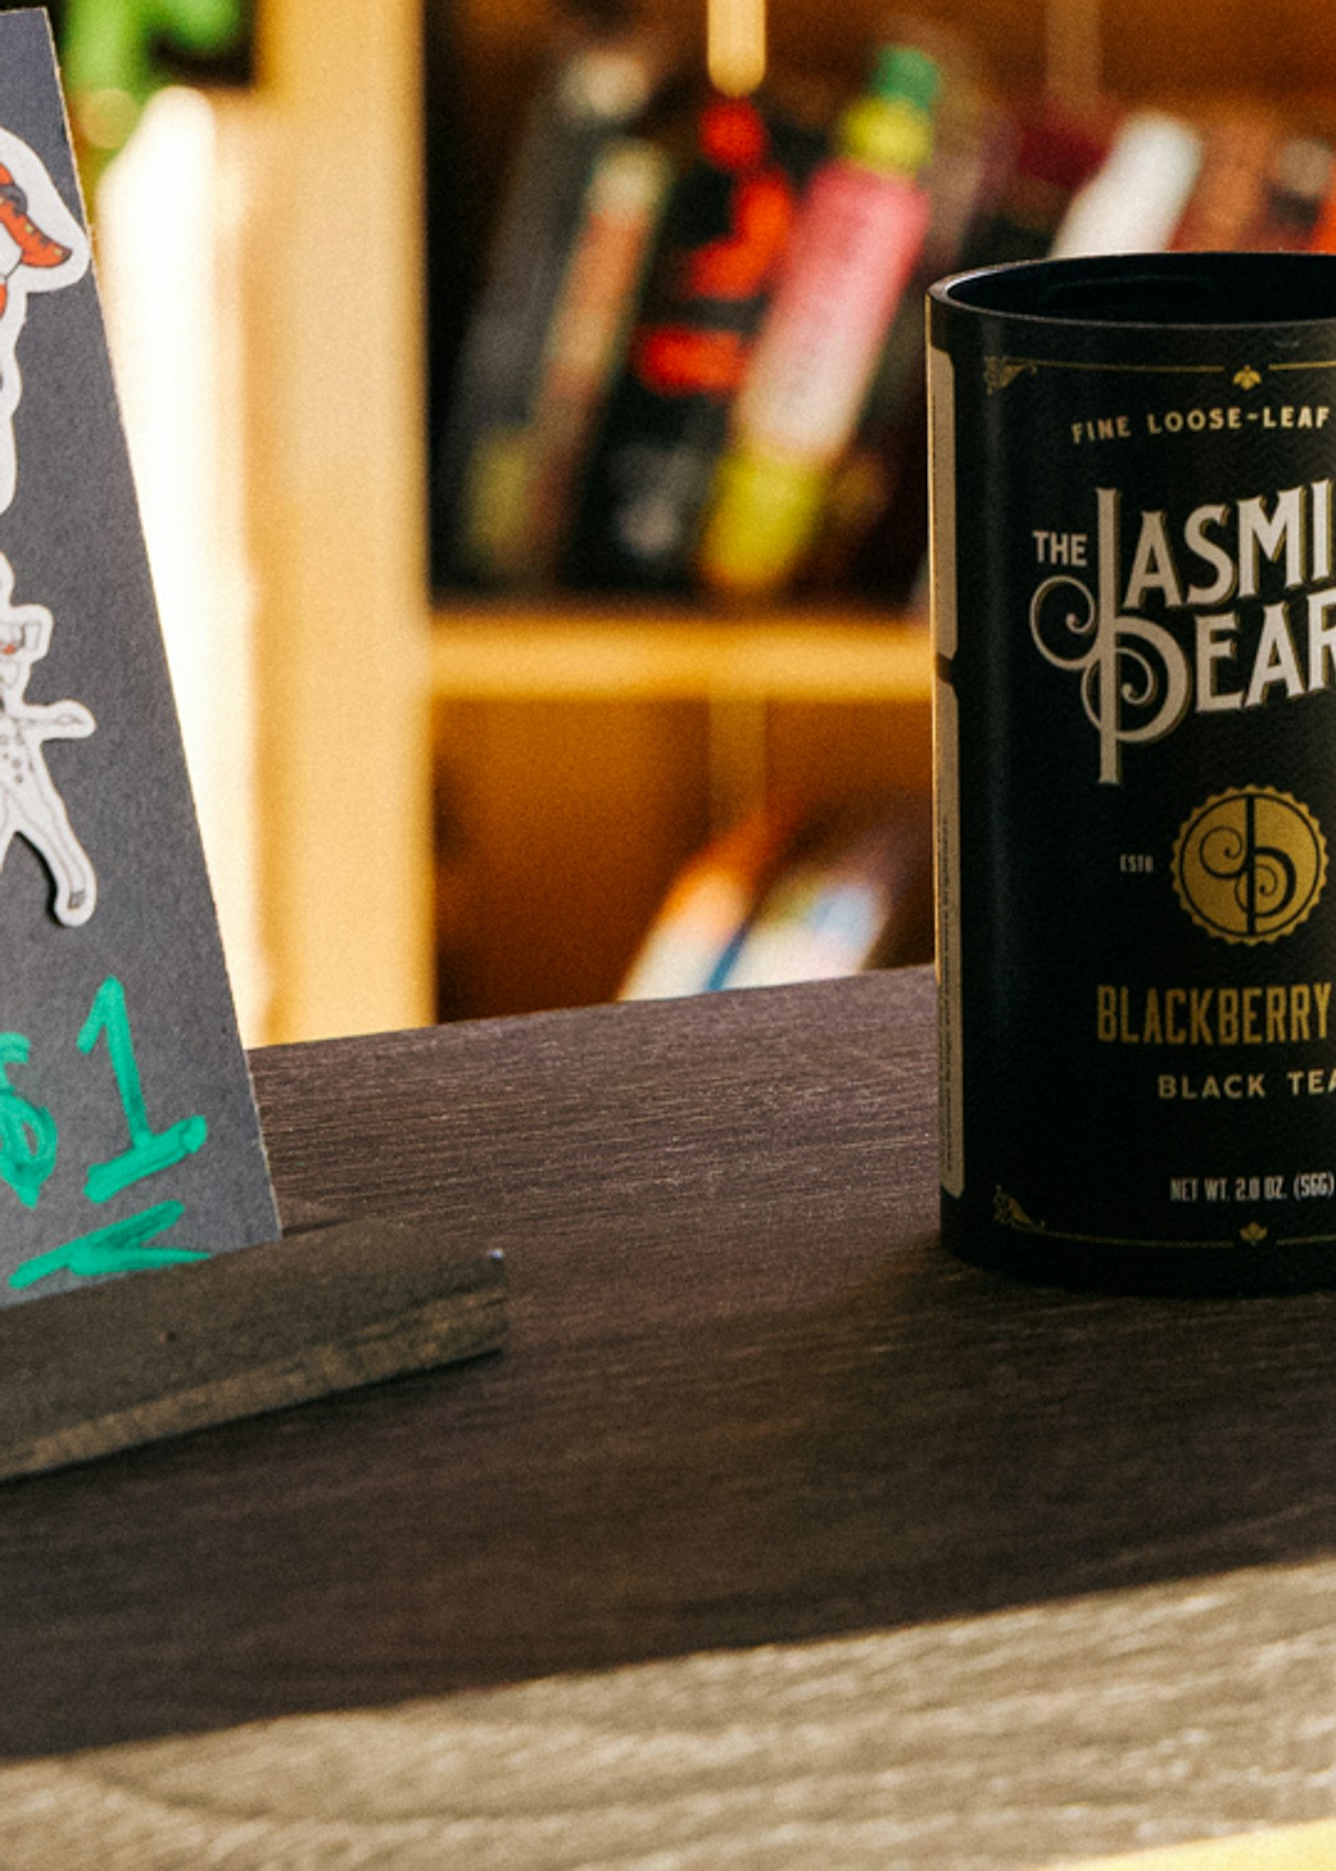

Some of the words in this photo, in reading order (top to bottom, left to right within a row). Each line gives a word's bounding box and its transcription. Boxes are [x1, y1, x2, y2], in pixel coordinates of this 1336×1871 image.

[1071, 415, 1131, 444] FINE
[1147, 405, 1330, 435] LOOSE-LEAF
[1033, 530, 1087, 568] THE
[1097, 983, 1332, 1045] BLACKBERRY
[1158, 1074, 1266, 1100] BLACK
[1169, 1177, 1199, 1202] NET
